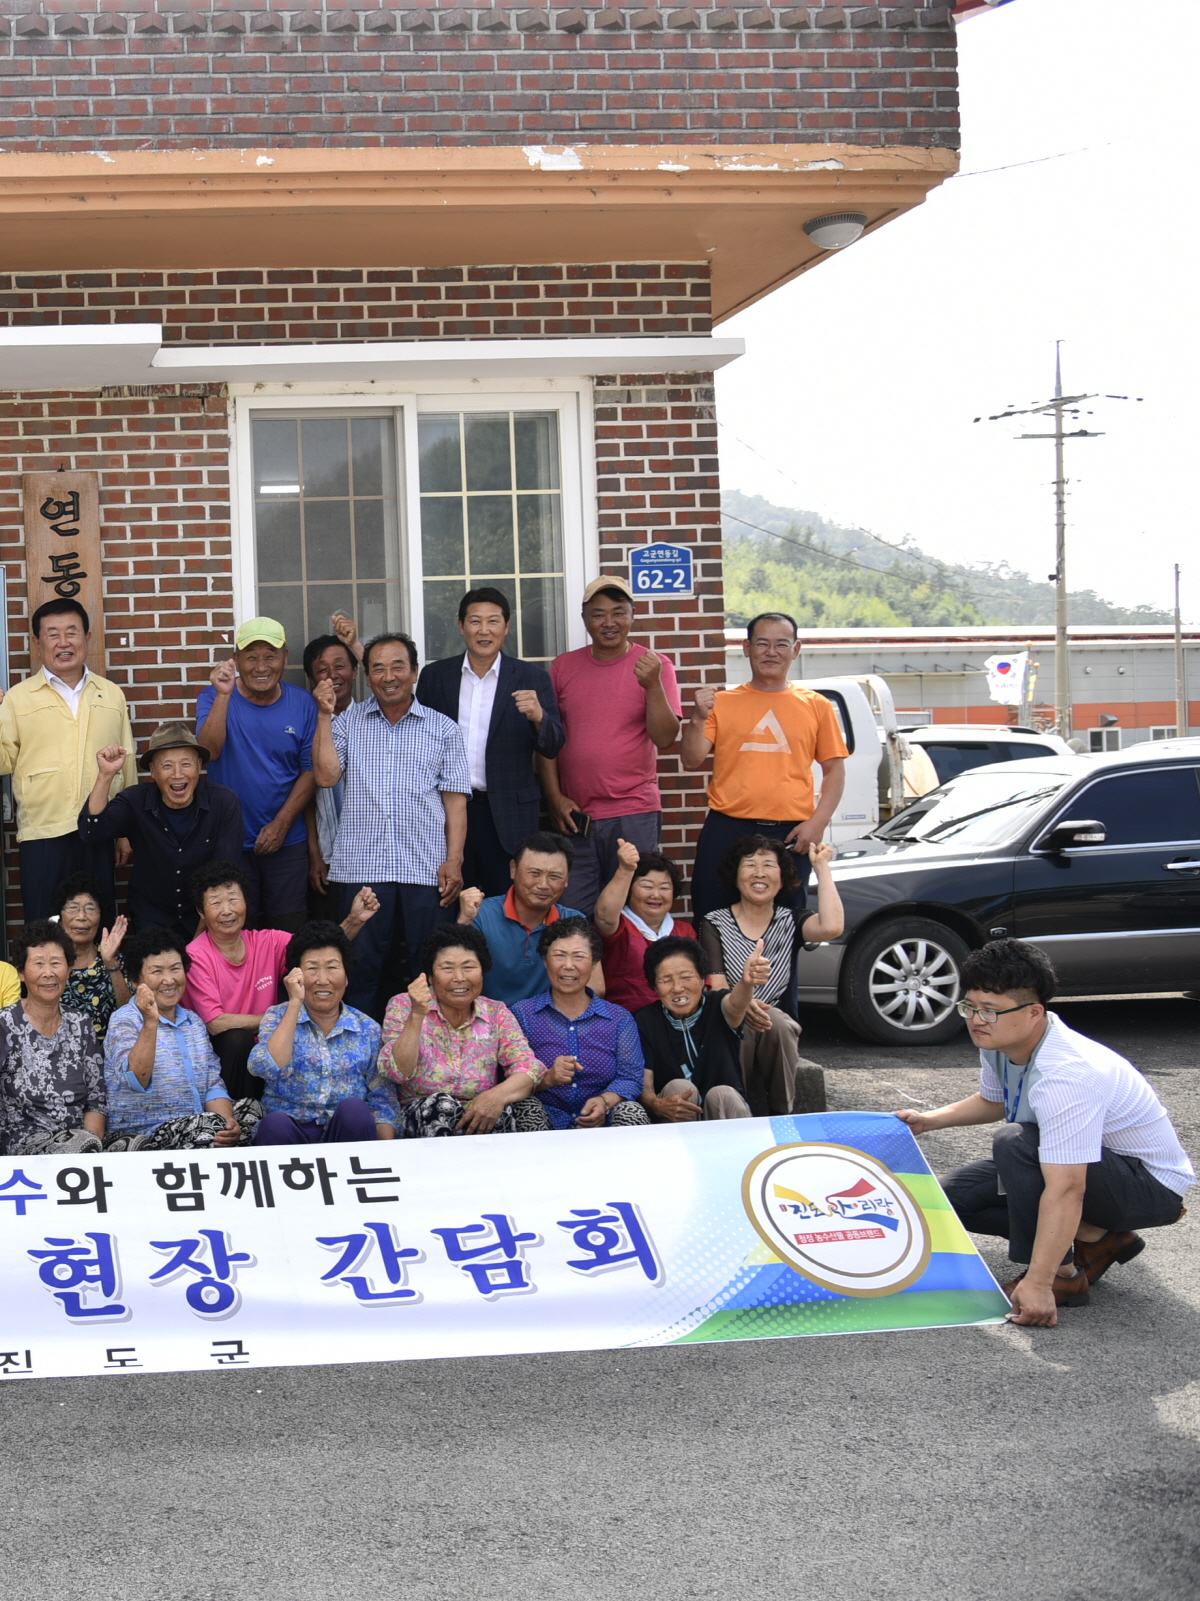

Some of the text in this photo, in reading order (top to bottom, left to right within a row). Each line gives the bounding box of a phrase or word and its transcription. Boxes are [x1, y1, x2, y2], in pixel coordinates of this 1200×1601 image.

[637, 569, 686, 590] 62-2
[152, 1157, 402, 1212] 함께하는
[27, 1229, 253, 1319] 현장
[316, 1201, 660, 1301] 간담회
